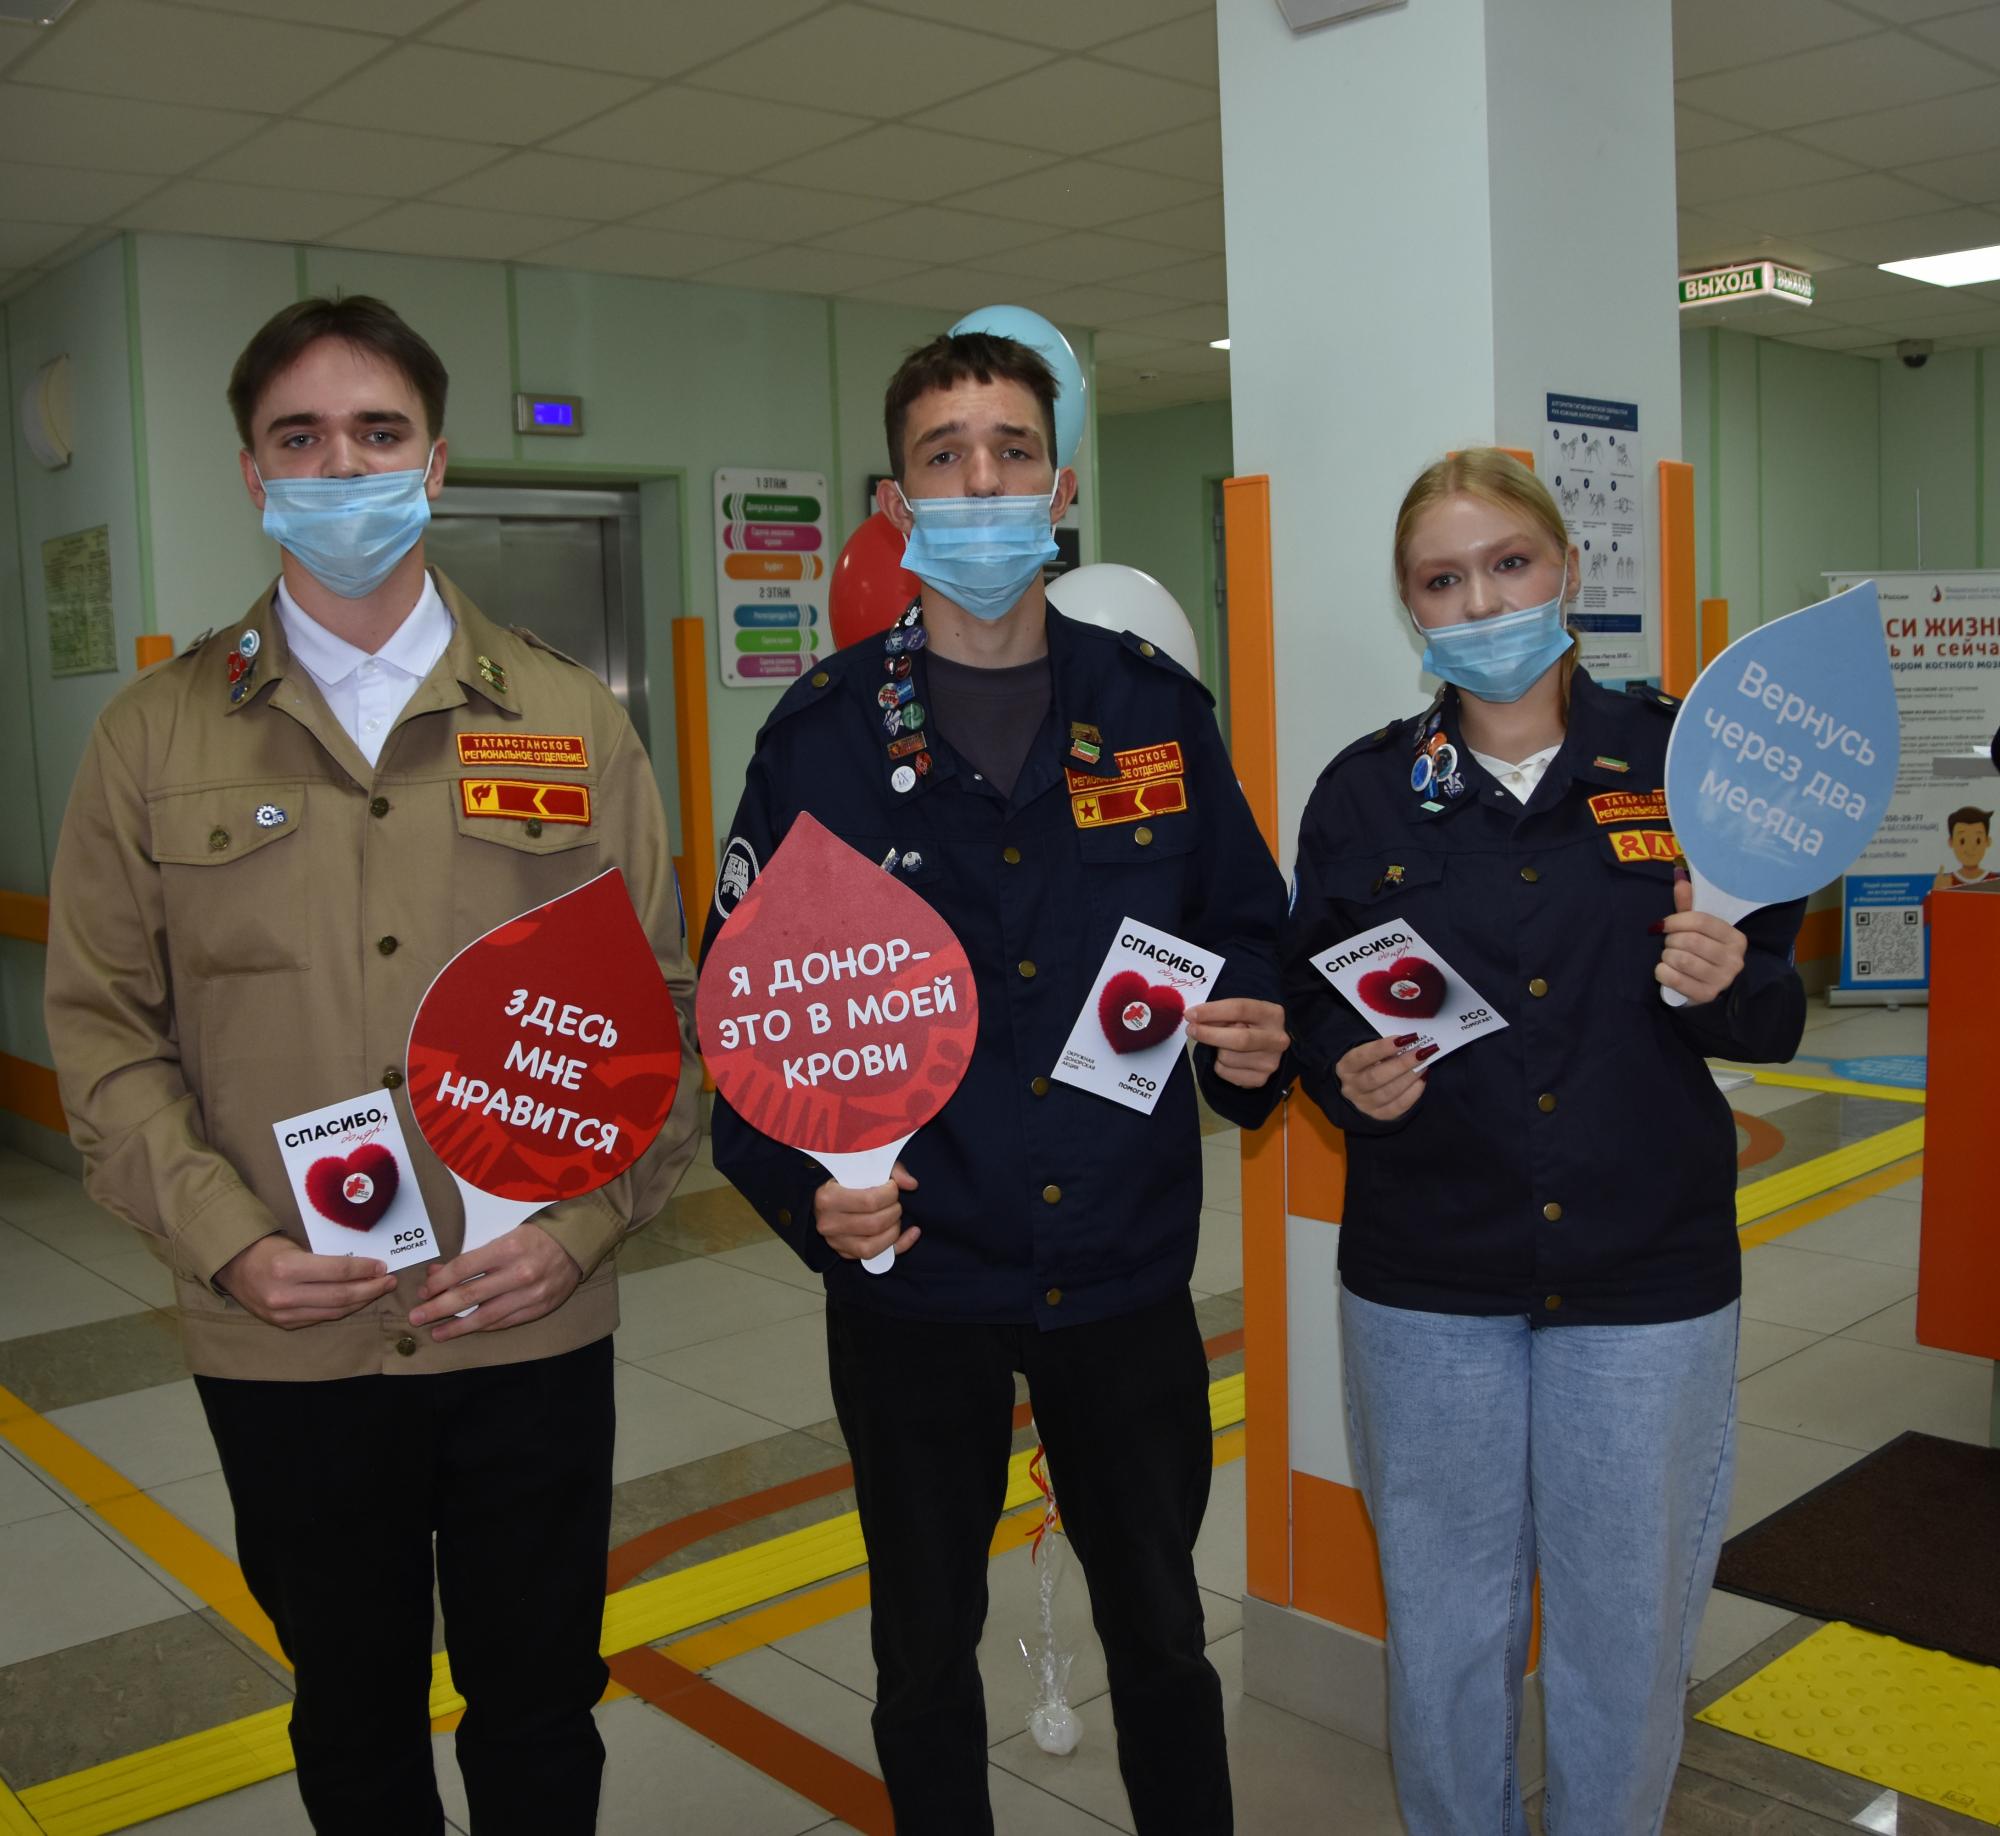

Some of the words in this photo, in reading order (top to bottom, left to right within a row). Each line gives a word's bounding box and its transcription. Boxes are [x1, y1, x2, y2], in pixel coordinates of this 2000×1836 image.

[1685, 270, 1756, 300] ВЫХОД
[1777, 270, 1812, 297] ВЫХОД
[1886, 618, 1917, 638] СИ
[1913, 644, 1924, 657] и
[1937, 638, 2000, 657] сейча
[1890, 662, 1922, 672] ором
[1925, 661, 1974, 670] костного
[1976, 660, 2000, 669] моз
[1737, 660, 1876, 766] Вернусь
[473, 738, 571, 750] ТАТАРСТАНСКОЕ
[464, 750, 533, 761] РЕГИОНАЛЬНОЕ
[535, 751, 583, 763] ОТДЕЛЕНИЕ
[1116, 749, 1168, 768] ТАНСКОЕ
[1703, 707, 1802, 782] через
[1802, 770, 1867, 821] два
[1132, 759, 1180, 778] ОТДЕЛЕНИЕ
[1605, 794, 1664, 807] ТАТАРСТАН
[1699, 769, 1824, 857] месяца
[1120, 934, 1207, 985] СПАСИБО,
[1325, 933, 1413, 973] СПАСИБО,
[729, 966, 751, 997] Я
[768, 938, 930, 997] ДОНОР-
[504, 989, 618, 1048] ЗДЕСЬ
[718, 1009, 791, 1049] ЭТО
[806, 1002, 832, 1035] В
[847, 975, 957, 1029] МОЕЙ
[1459, 1008, 1488, 1023] РСО
[1460, 1015, 1493, 1031] ПОМОГАЕТ
[503, 1040, 588, 1090] МНЕ
[782, 1043, 907, 1089] КРОВИ
[1061, 1060, 1079, 1071] АКЦИЯ
[1063, 1056, 1096, 1071] ДОНОРСКАЯ
[1066, 1050, 1095, 1064] ОКРУЖНАЯ
[1118, 1081, 1152, 1100] ПОМОГАЕТ
[1128, 1073, 1157, 1092] РСО
[436, 1071, 619, 1154] НРАВИТСЯ
[284, 1108, 388, 1148] СПАСИБО,
[393, 1227, 425, 1245] РСО
[390, 1239, 428, 1255] ПОМОГАЕТ
